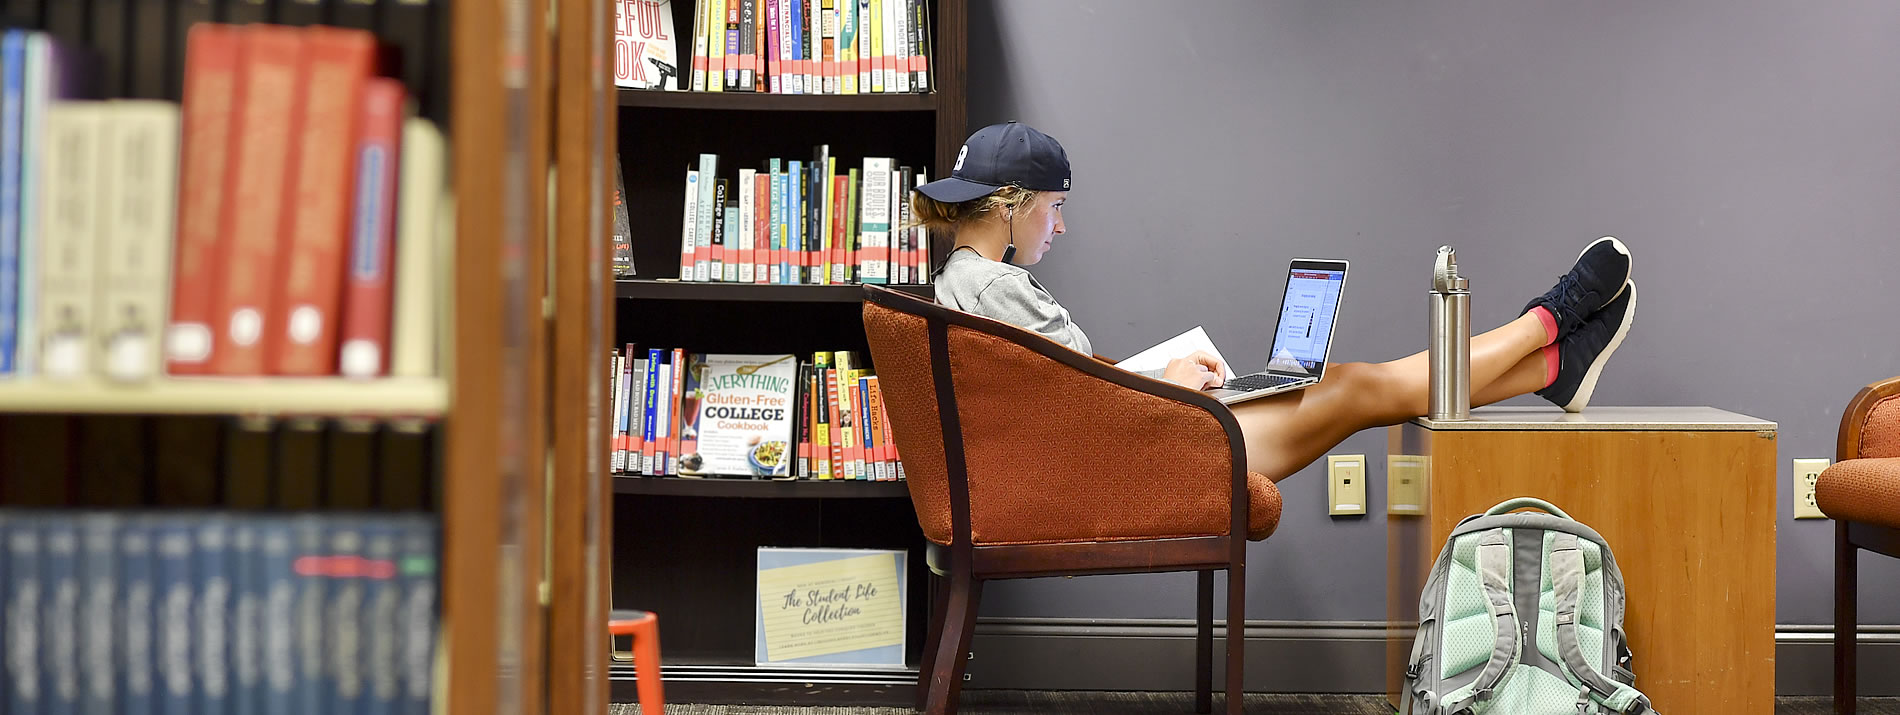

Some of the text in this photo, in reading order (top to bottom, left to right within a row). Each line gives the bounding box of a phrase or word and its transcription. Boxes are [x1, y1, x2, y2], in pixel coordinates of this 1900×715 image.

[616, 0, 668, 40] EFUL
[616, 40, 646, 81] OK
[873, 171, 886, 186] OUR
[715, 185, 724, 217] College
[709, 374, 789, 393] EVERYTHING
[706, 393, 785, 406] Gluten-Free
[705, 406, 784, 420] COLLEGE
[717, 420, 768, 431] Cookbook
[782, 582, 878, 610] The Student Life
[803, 604, 862, 625] Collection
